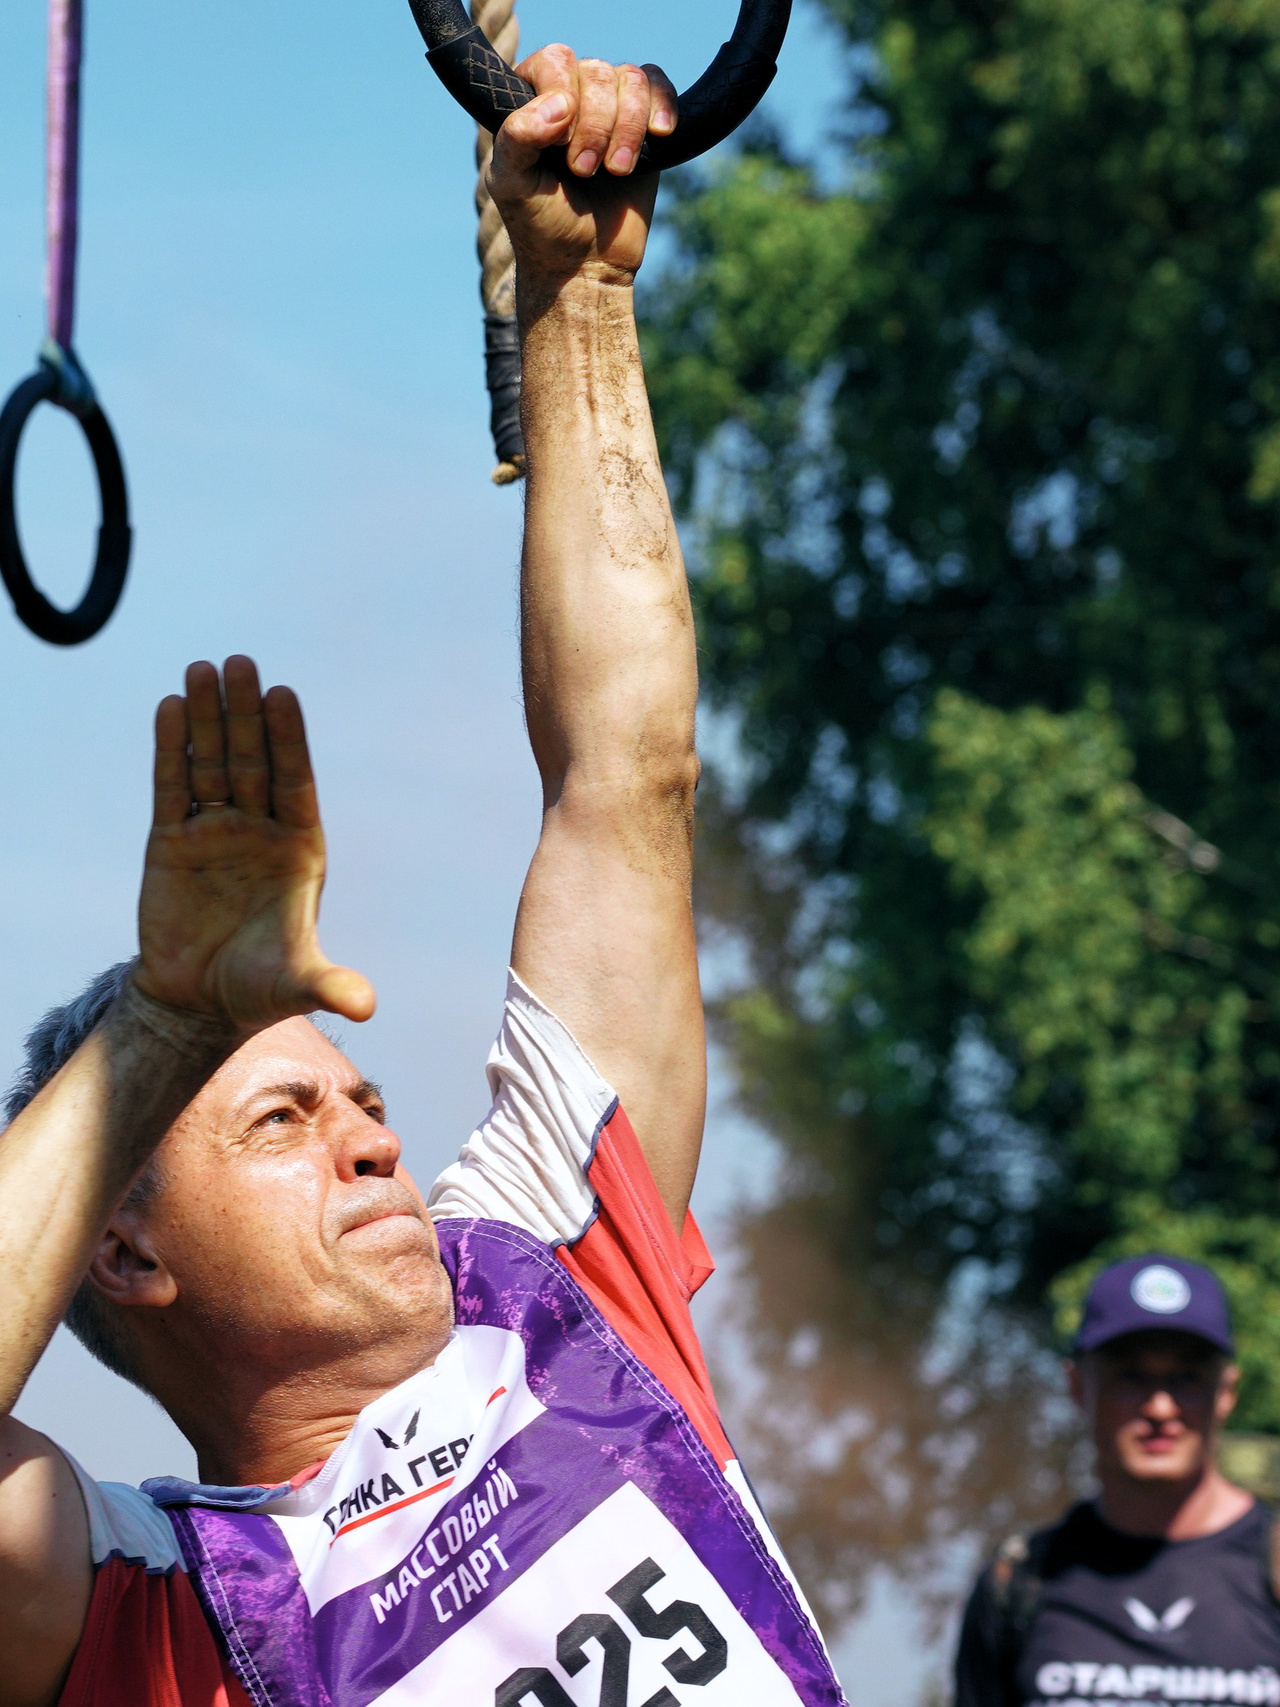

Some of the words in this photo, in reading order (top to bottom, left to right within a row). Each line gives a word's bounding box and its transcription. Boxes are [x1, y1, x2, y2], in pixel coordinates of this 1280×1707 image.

[407, 1434, 475, 1488] ГЕР
[369, 1457, 519, 1624] МАССОВЫЙ
[429, 1533, 510, 1624] СТАРТ
[495, 1557, 729, 1707] 25
[1034, 1659, 1280, 1706] СТАРШИЙ
